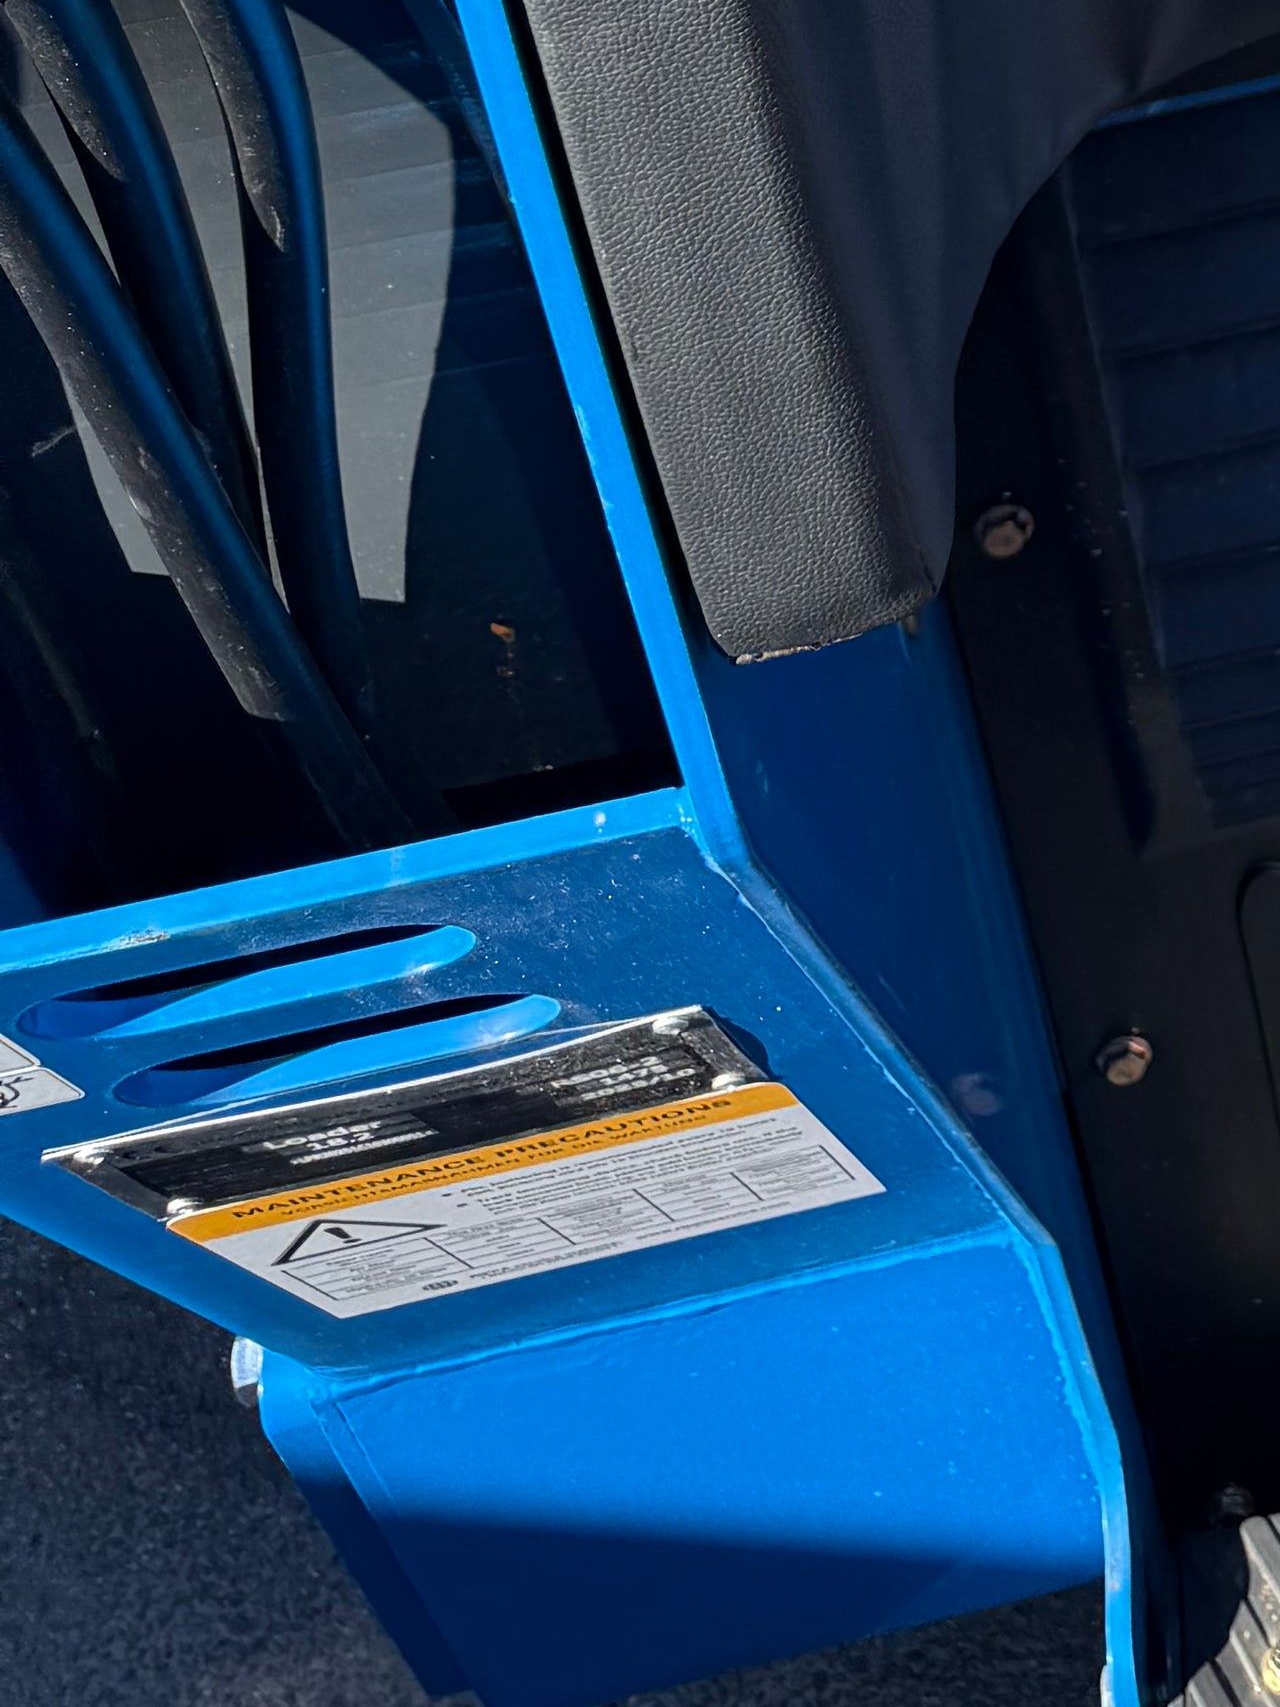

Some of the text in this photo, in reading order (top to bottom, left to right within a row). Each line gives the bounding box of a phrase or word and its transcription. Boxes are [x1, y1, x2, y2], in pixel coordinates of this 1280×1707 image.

[232, 1155, 486, 1219] MAINTENANCE
[494, 1098, 732, 1159] PRECAUTIONS
[262, 1120, 382, 1150] Loader
